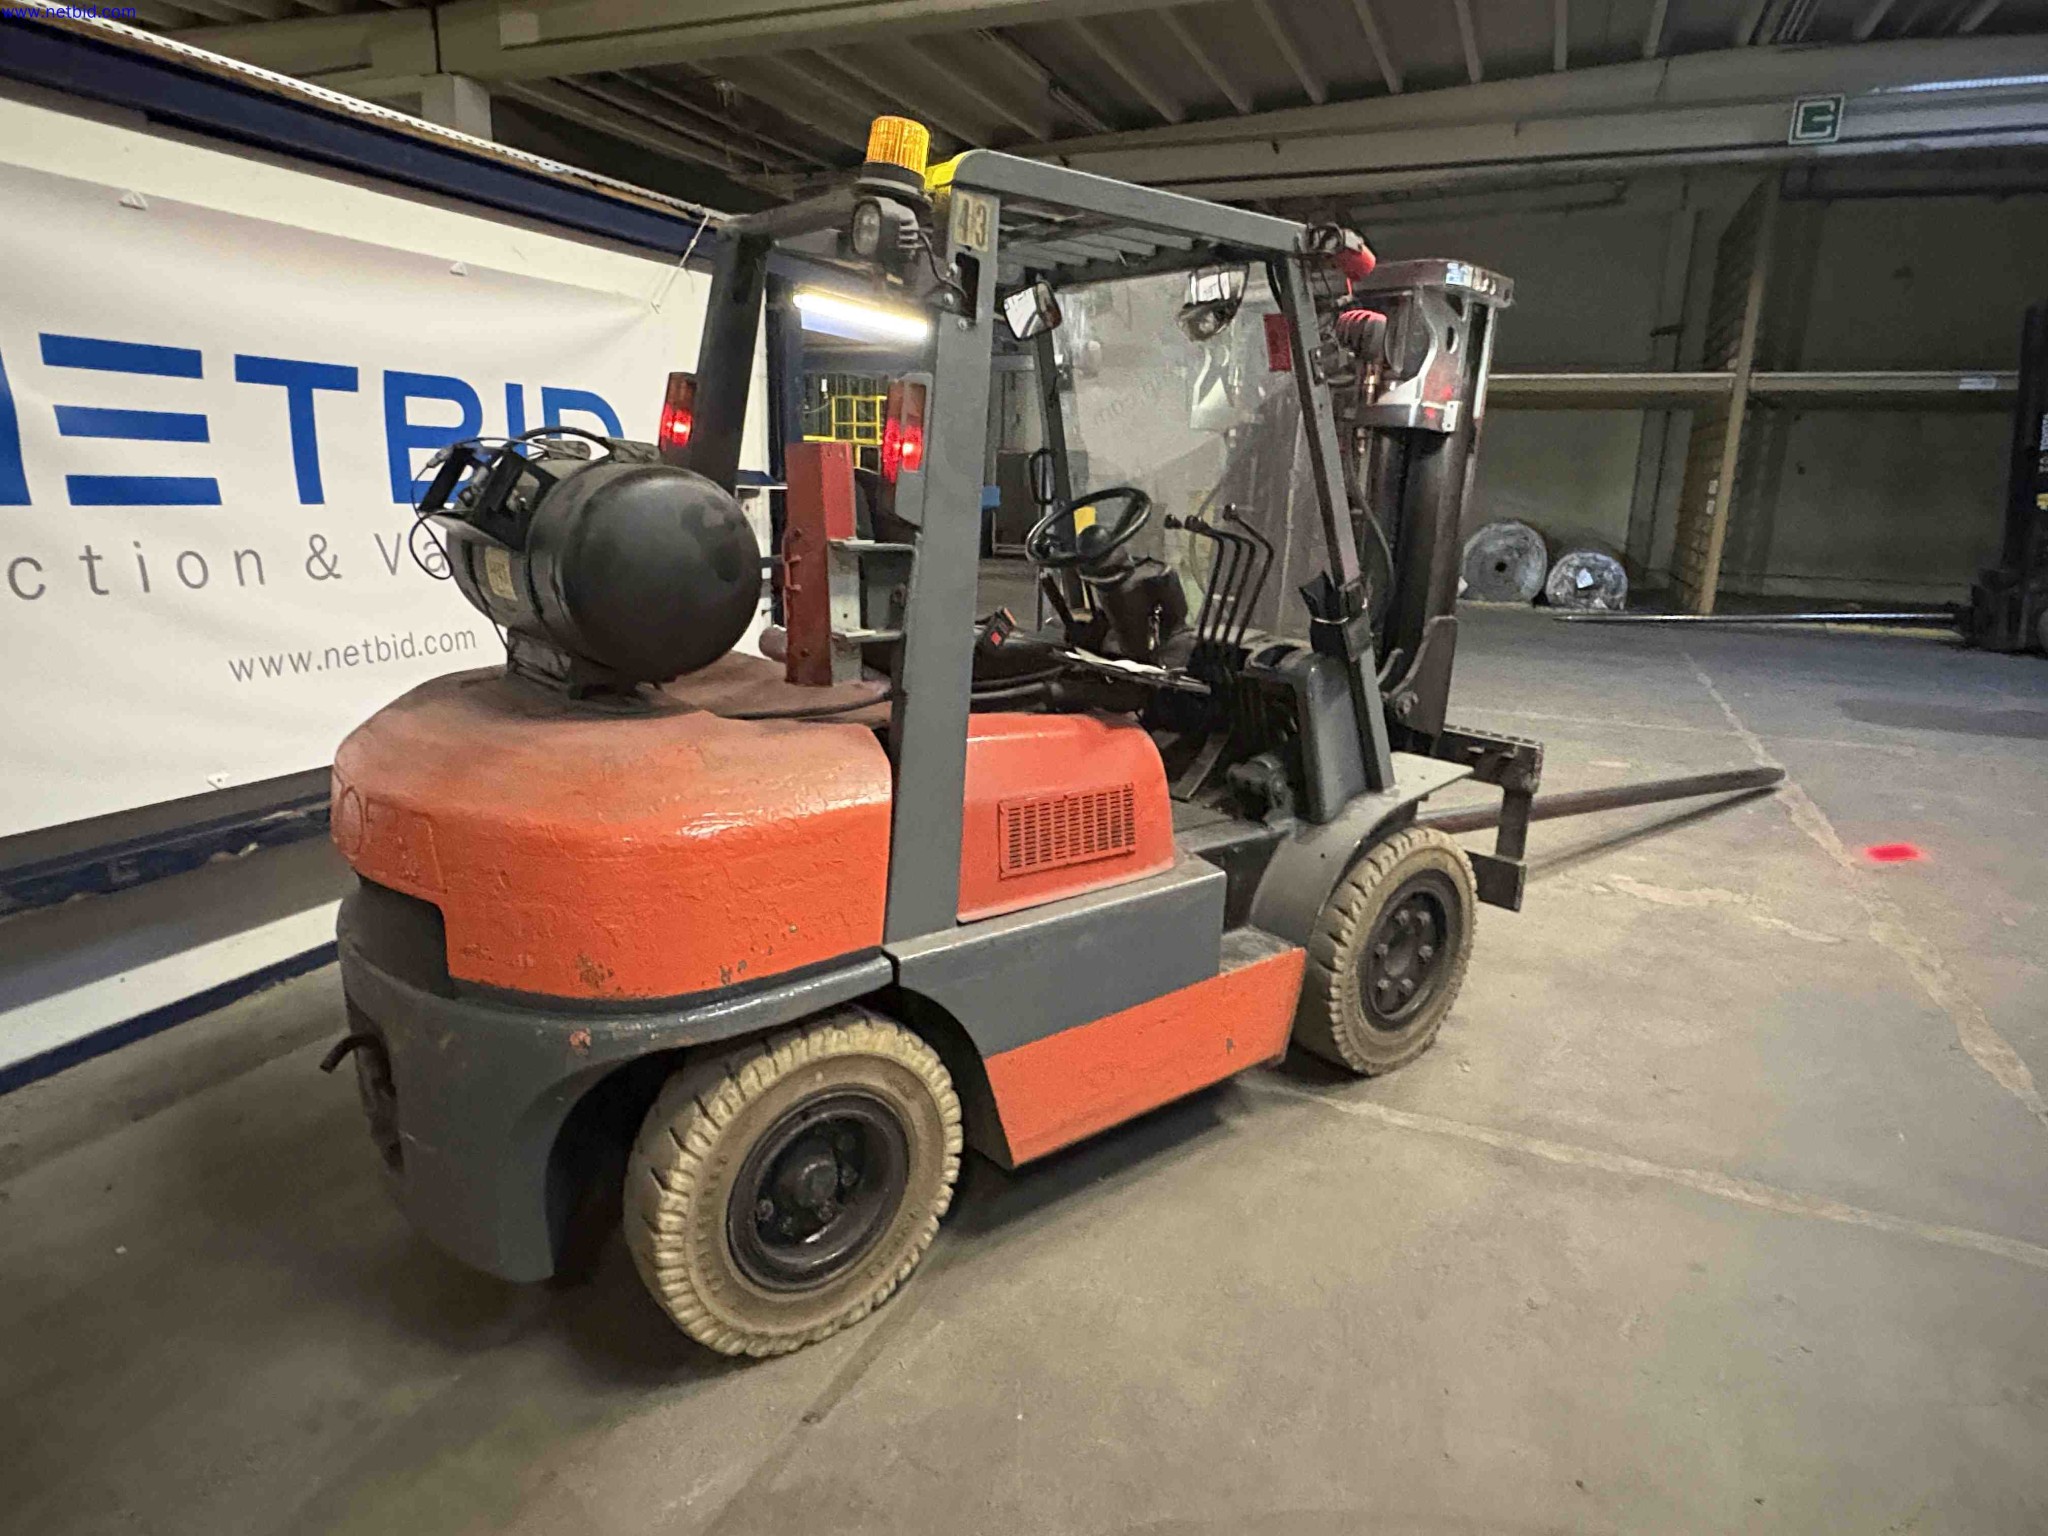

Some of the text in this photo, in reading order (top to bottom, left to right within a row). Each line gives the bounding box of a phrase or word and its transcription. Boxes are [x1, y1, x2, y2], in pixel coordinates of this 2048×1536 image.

[0, 333, 623, 505] ETBI
[8, 541, 265, 600] ction
[305, 534, 342, 581] &
[228, 629, 476, 682] www.netbid.com
